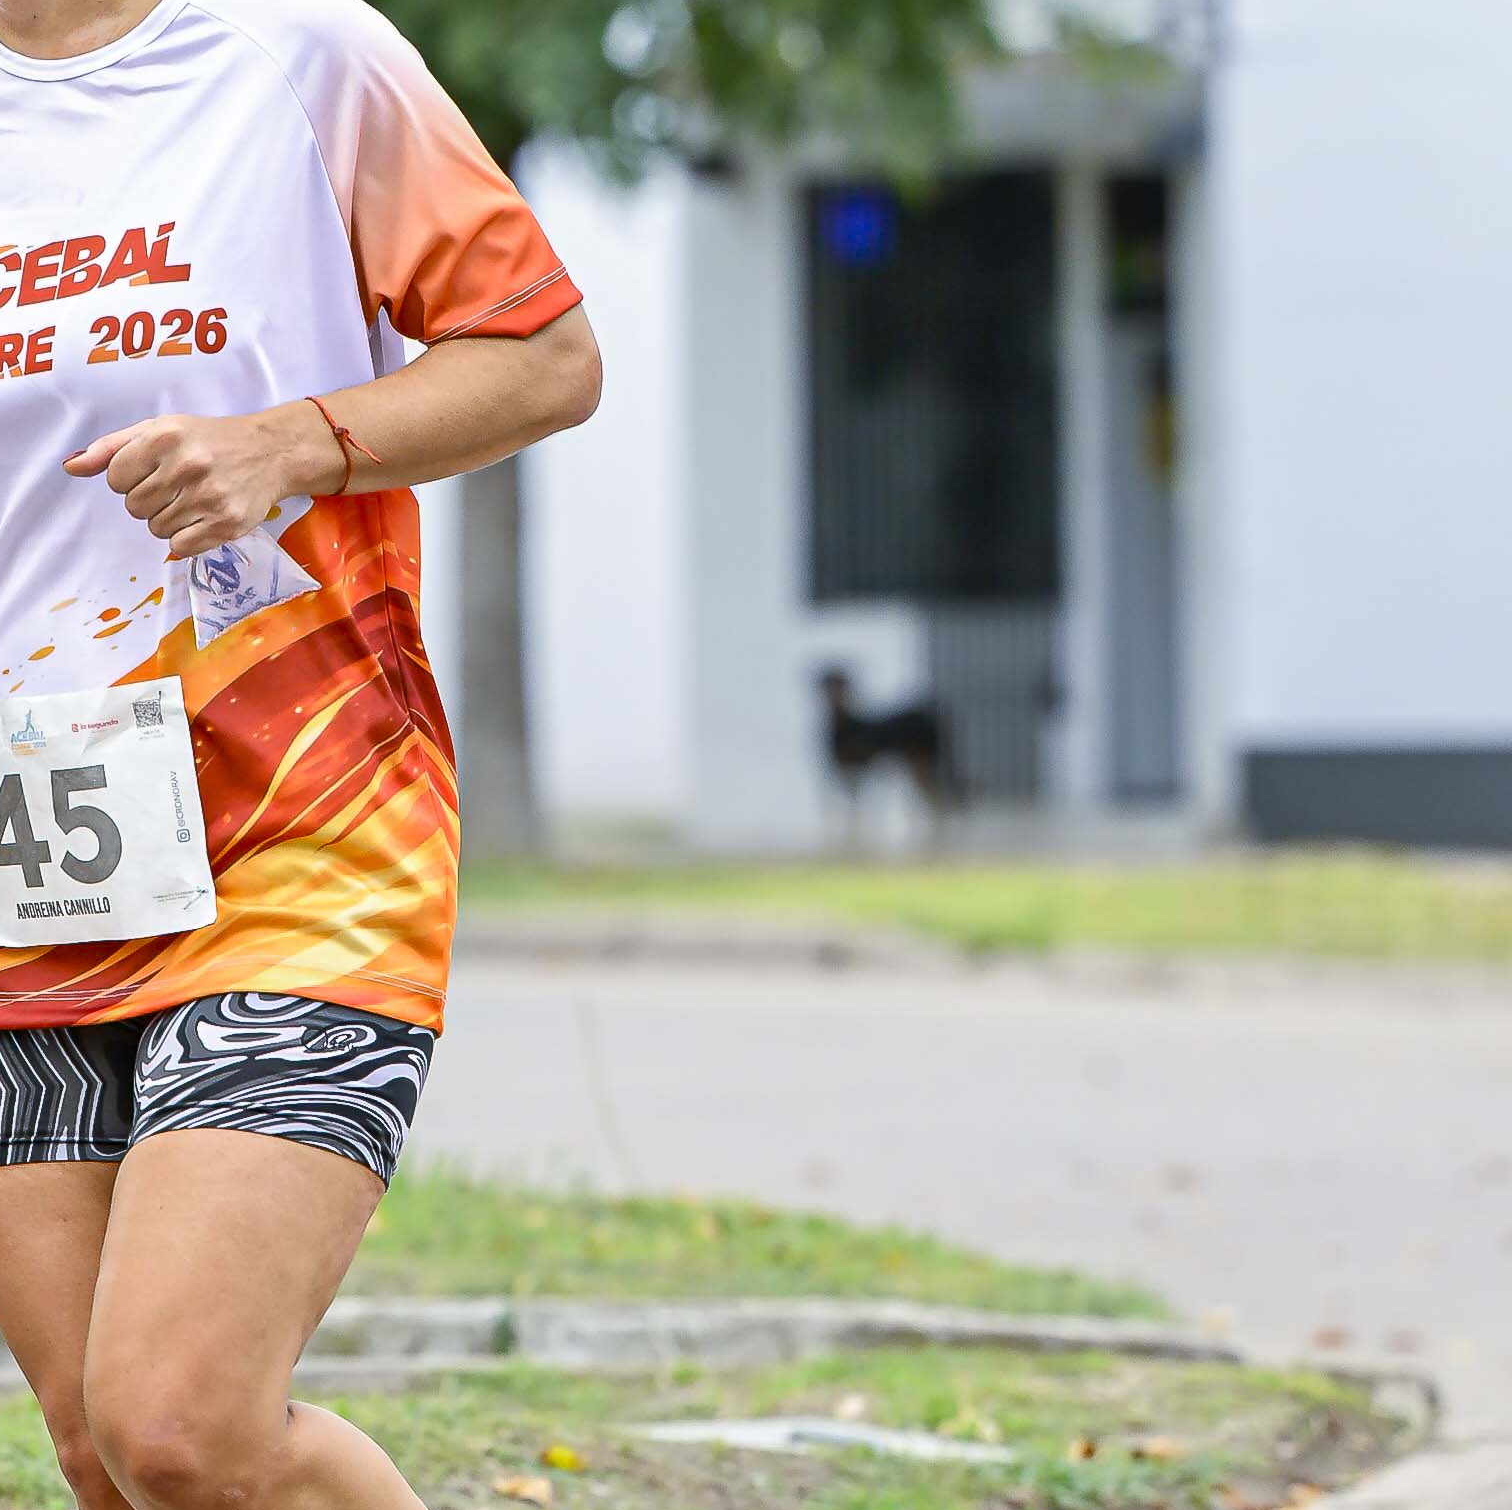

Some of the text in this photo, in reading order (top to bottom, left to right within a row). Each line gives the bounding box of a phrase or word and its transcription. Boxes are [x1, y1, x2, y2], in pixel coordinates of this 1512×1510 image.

[87, 307, 228, 365] 2026
[16, 896, 111, 920] ANDREINA CANNILLO
